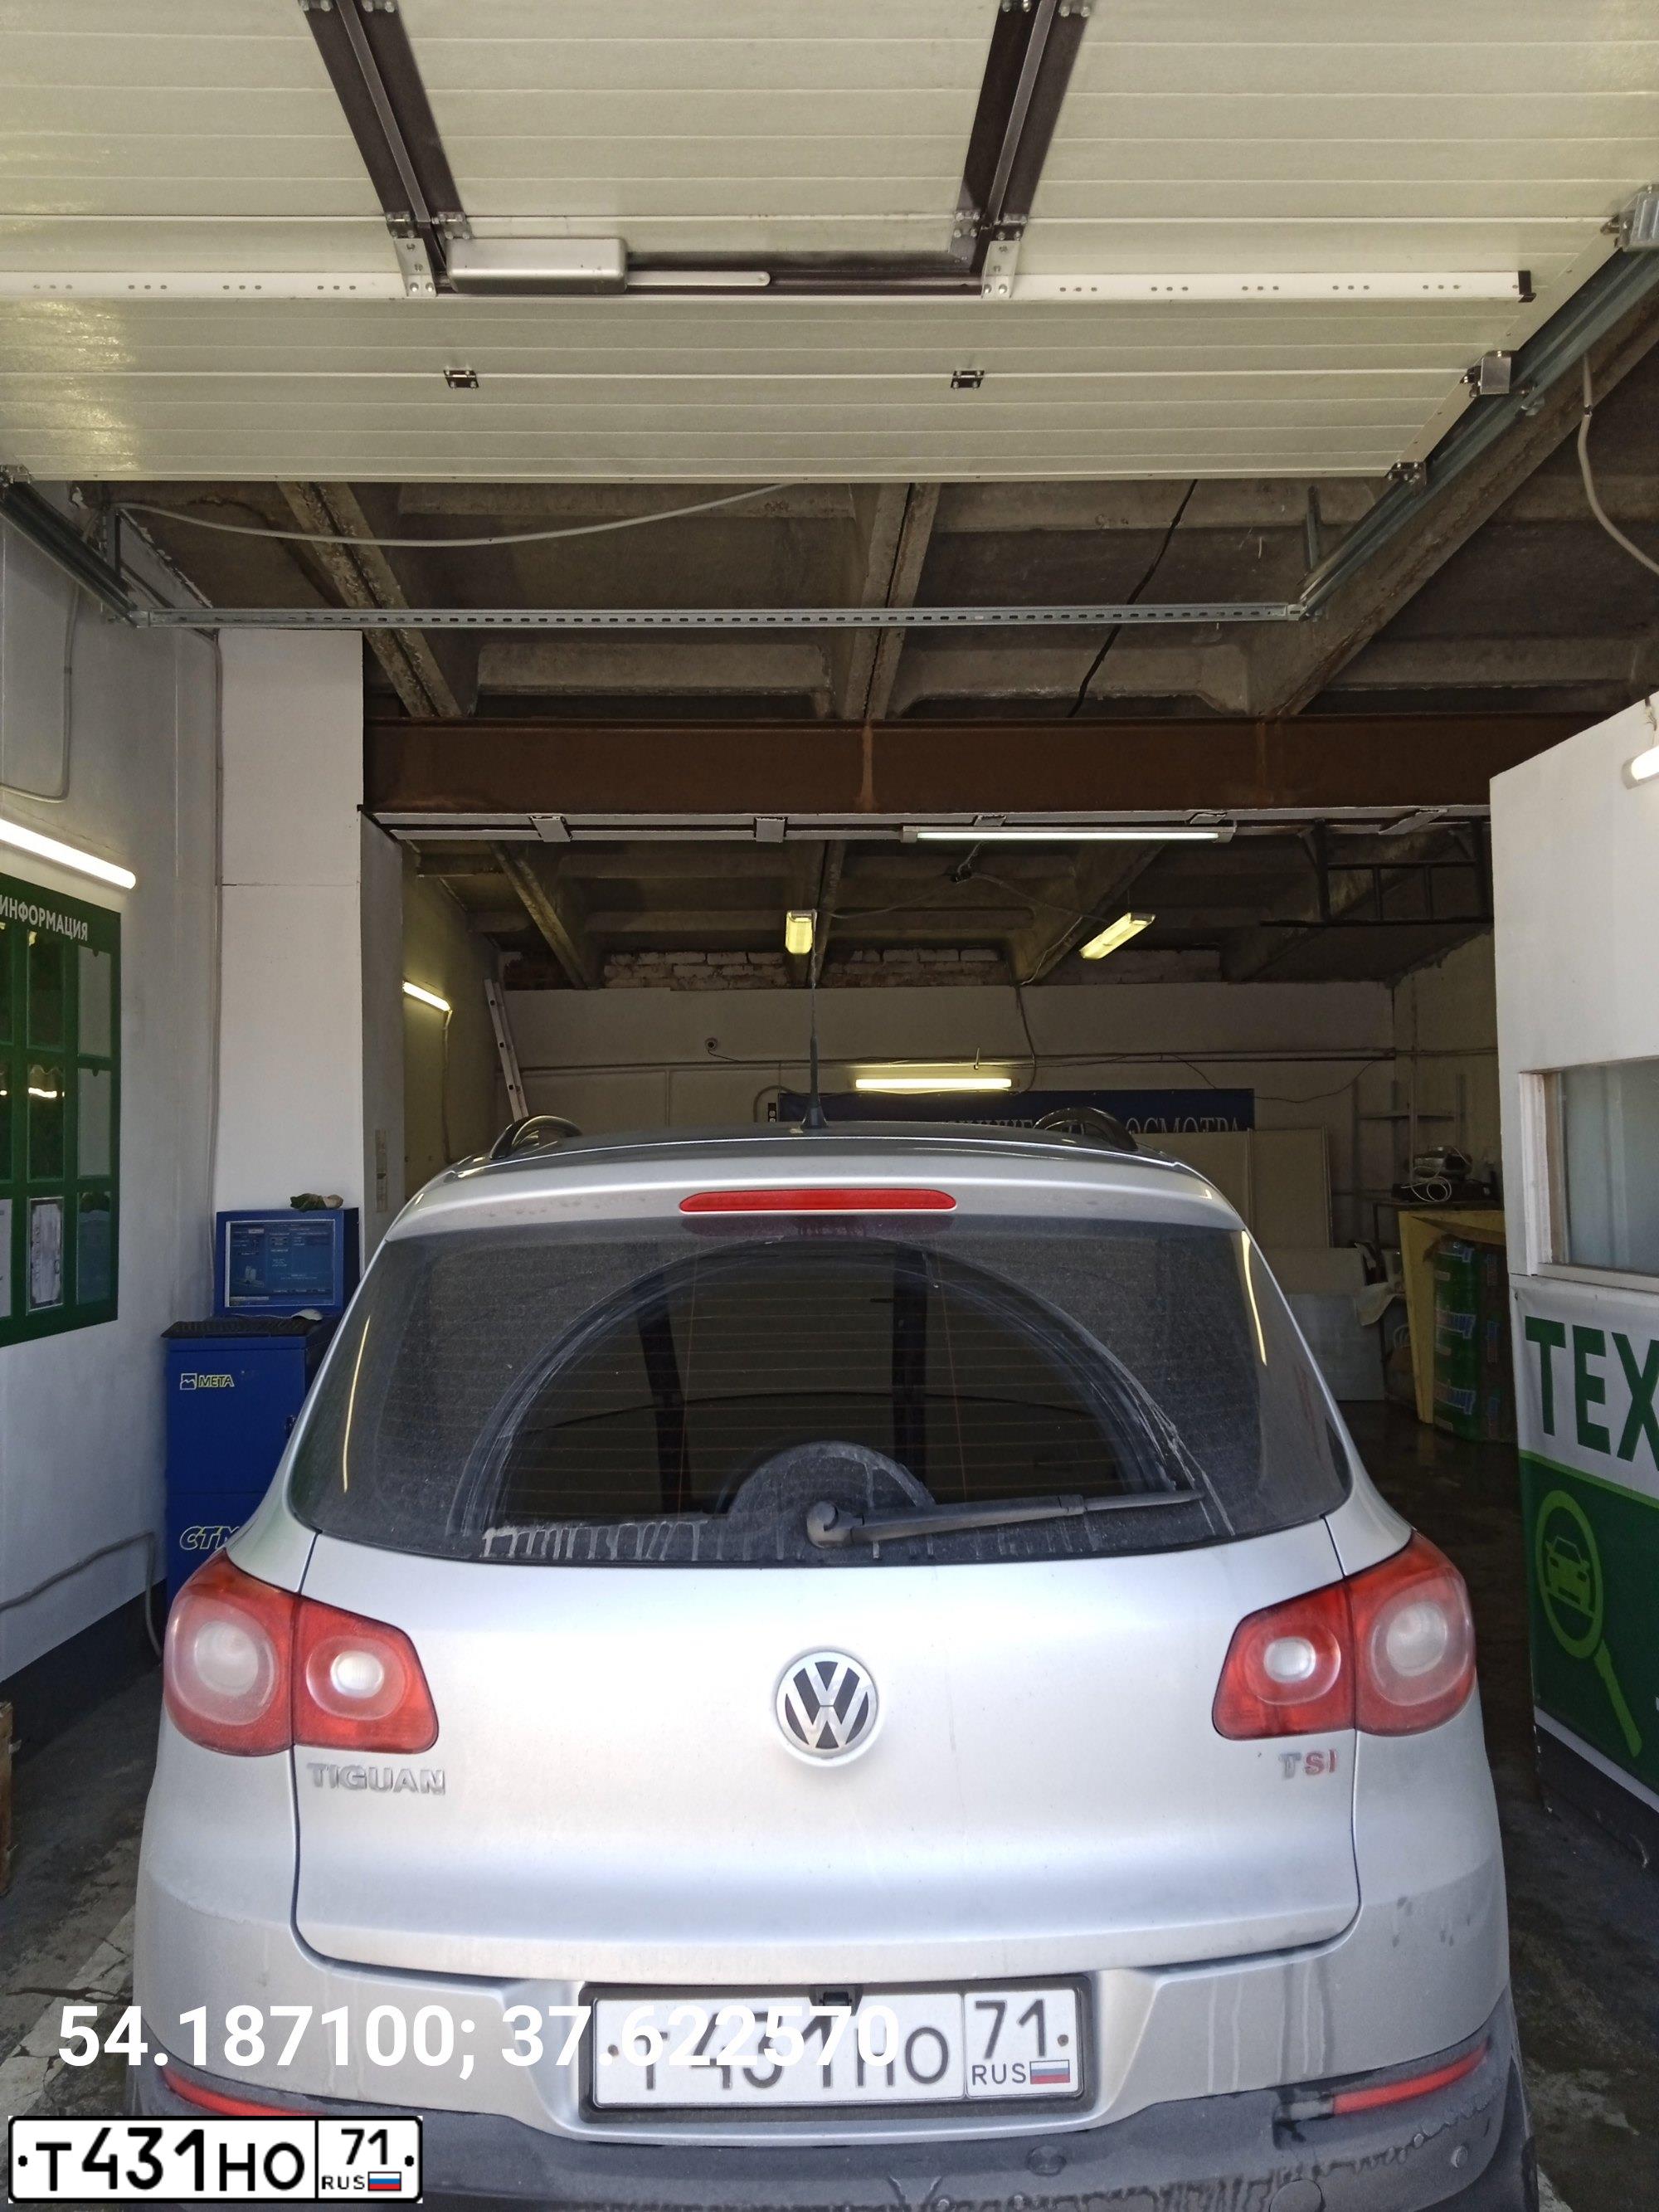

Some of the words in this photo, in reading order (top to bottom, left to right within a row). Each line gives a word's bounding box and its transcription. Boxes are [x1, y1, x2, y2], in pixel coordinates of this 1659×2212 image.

[0, 894, 88, 941] ИНФОРМАЦИЯ
[307, 1762, 446, 1795] TIGUAN
[1278, 1748, 1337, 1780] TSI
[975, 1999, 1046, 2059] 71
[971, 2063, 1026, 2085] RUS
